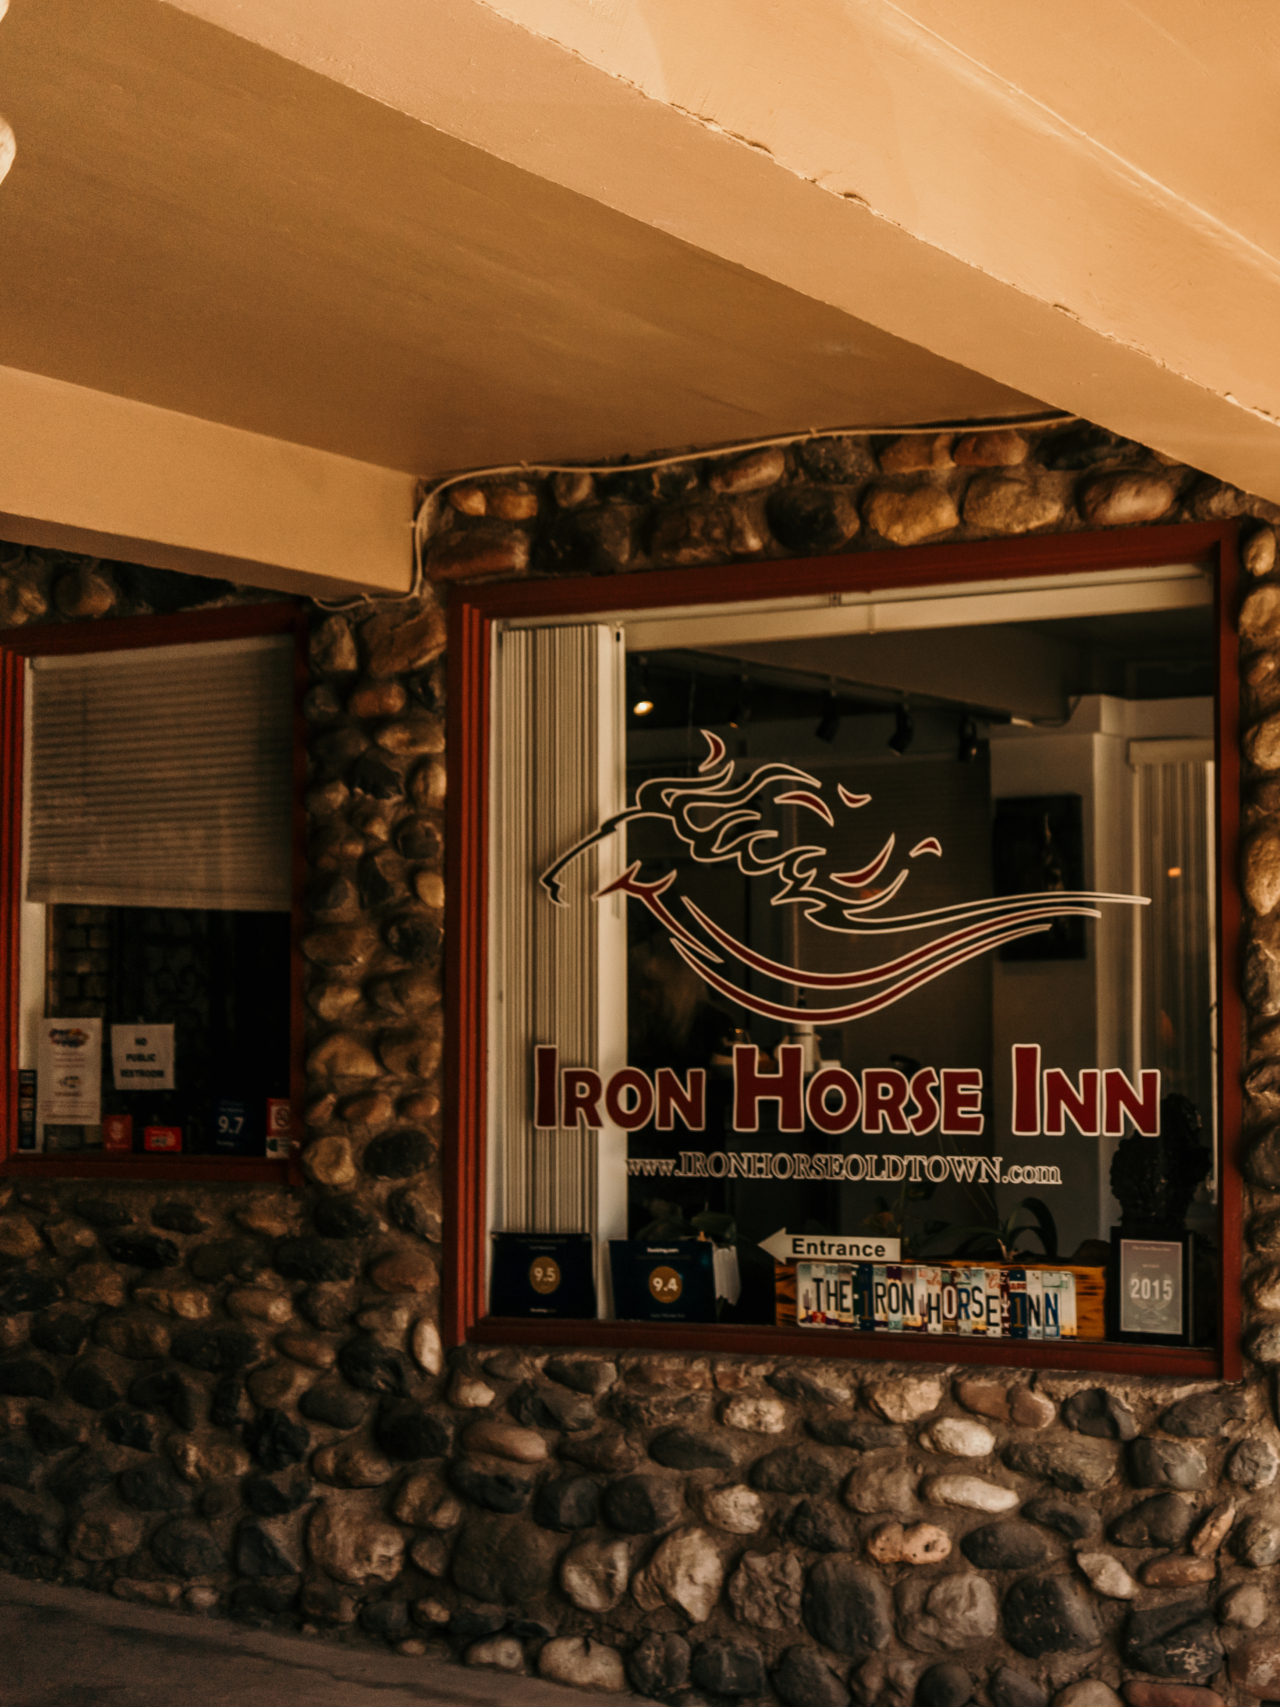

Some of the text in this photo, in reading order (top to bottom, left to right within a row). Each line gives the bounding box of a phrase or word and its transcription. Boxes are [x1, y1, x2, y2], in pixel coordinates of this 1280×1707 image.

[135, 1038, 147, 1046] NO
[126, 1054, 155, 1062] PUBLIC
[121, 1069, 164, 1078] RESTROOM
[217, 1115, 244, 1134] 9.7
[791, 1237, 886, 1259] Entrance
[533, 1267, 556, 1283] 9.5
[652, 1277, 678, 1292] 9.4
[1130, 1278, 1173, 1301] 2015
[812, 1278, 851, 1313] THE
[927, 1285, 1000, 1327] HORSE
